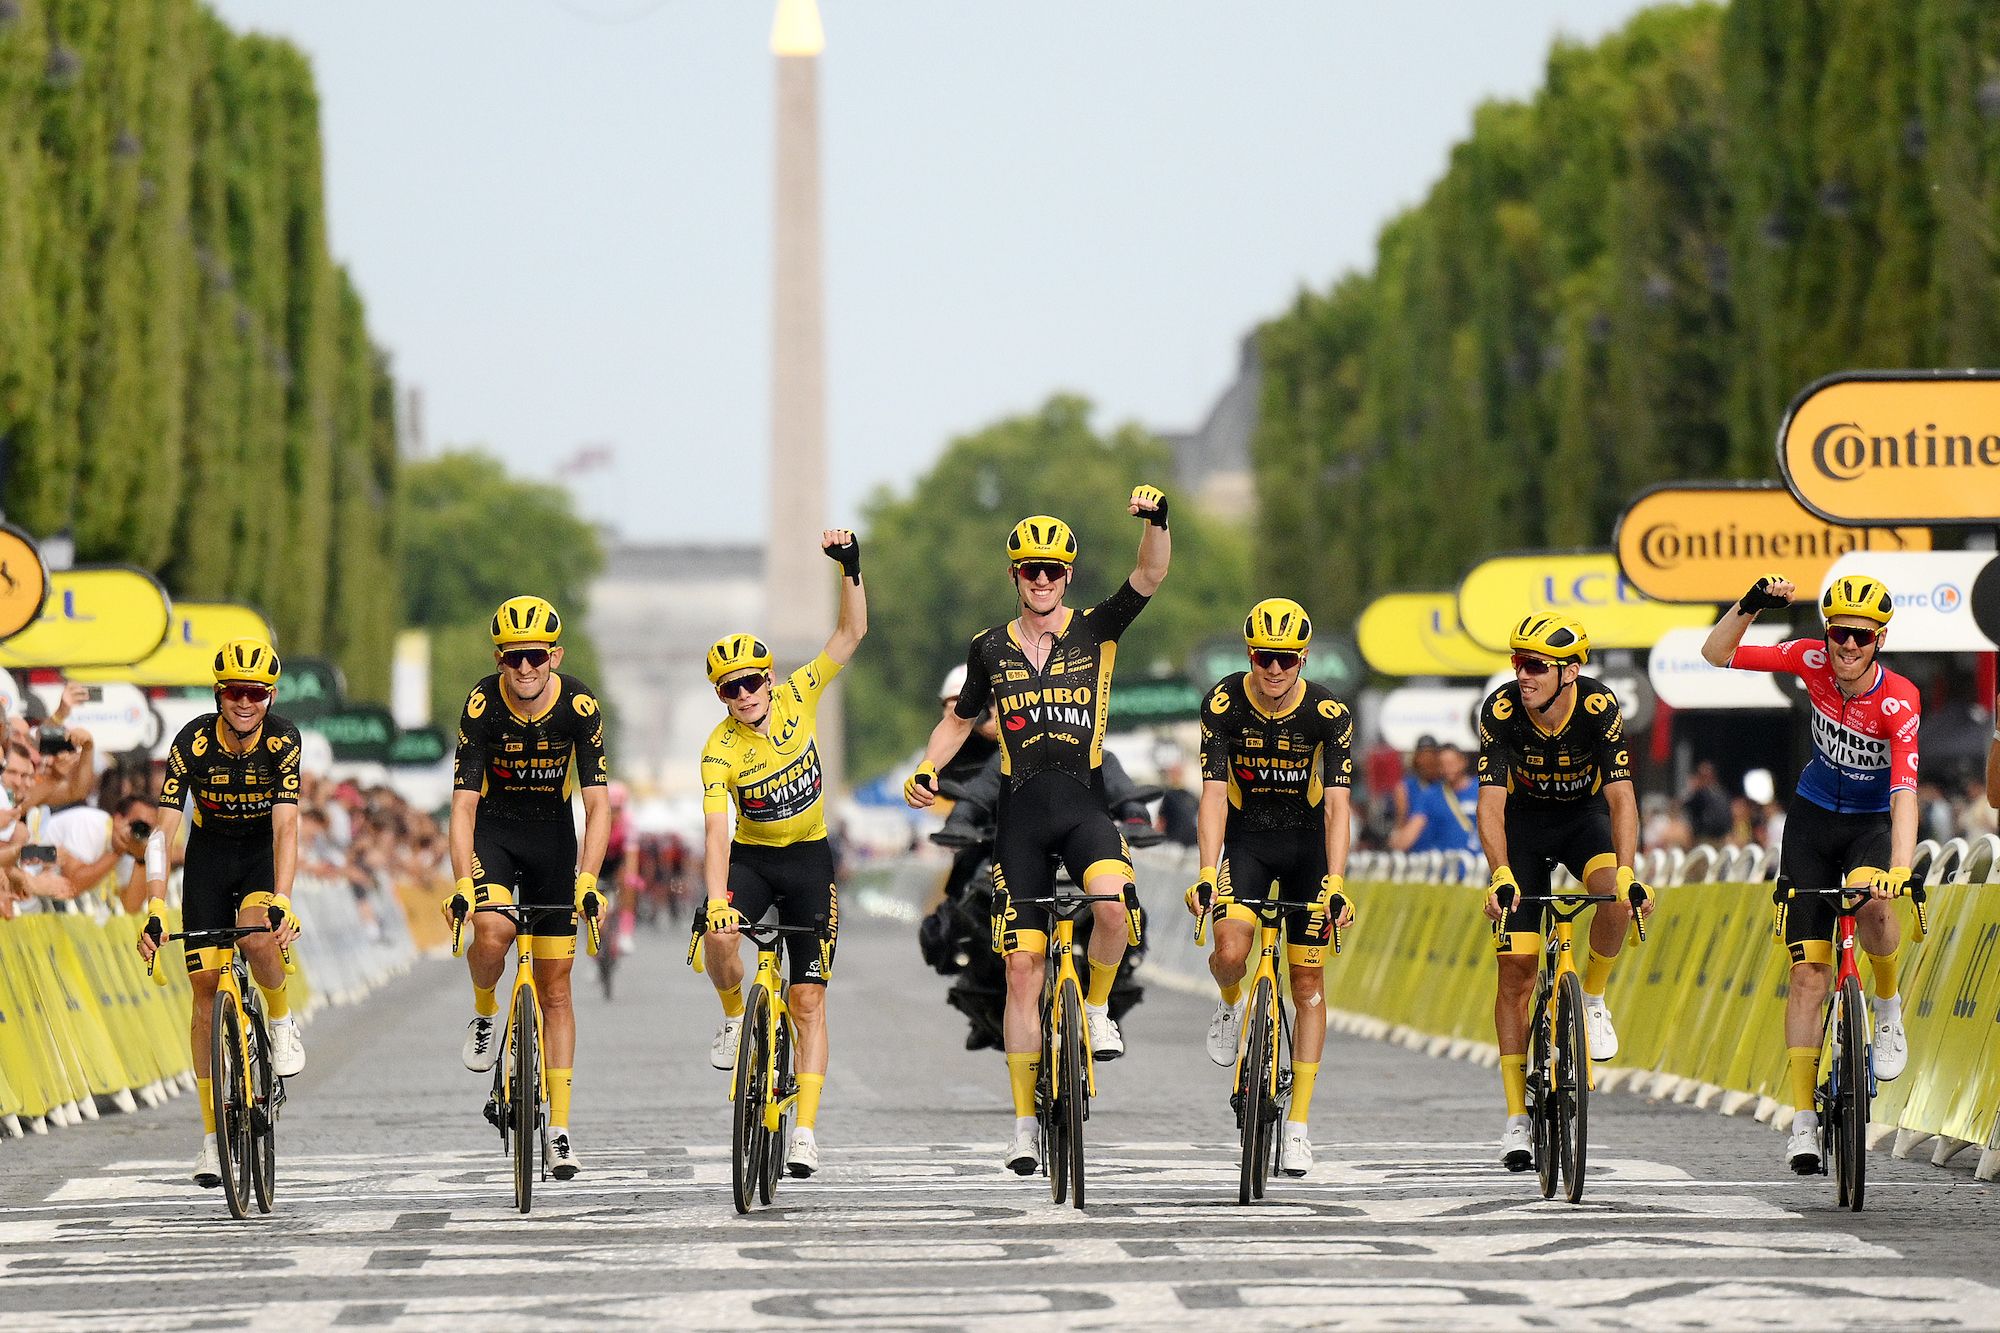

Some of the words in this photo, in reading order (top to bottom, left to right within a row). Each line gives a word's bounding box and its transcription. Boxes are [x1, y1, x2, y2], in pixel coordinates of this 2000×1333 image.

[1001, 687, 1091, 715] JUMBO
[1029, 706, 1091, 729] VISMA
[720, 728, 735, 745] LCL
[773, 715, 799, 747] LCL
[1811, 708, 1886, 753] JUMBO
[1235, 754, 1309, 768] JUMBO
[1616, 750, 1629, 766] G
[1826, 739, 1889, 767] VISMA
[492, 755, 567, 769] JUMBO
[738, 759, 768, 779] santini
[517, 766, 563, 779] VISMA
[744, 750, 815, 799] JUMBO
[1258, 769, 1307, 782] VISMA
[1516, 764, 1592, 781] JUMBO
[163, 778, 179, 795] G
[282, 774, 299, 790] G
[770, 765, 820, 804] VISMA
[1539, 775, 1591, 792] VISMA
